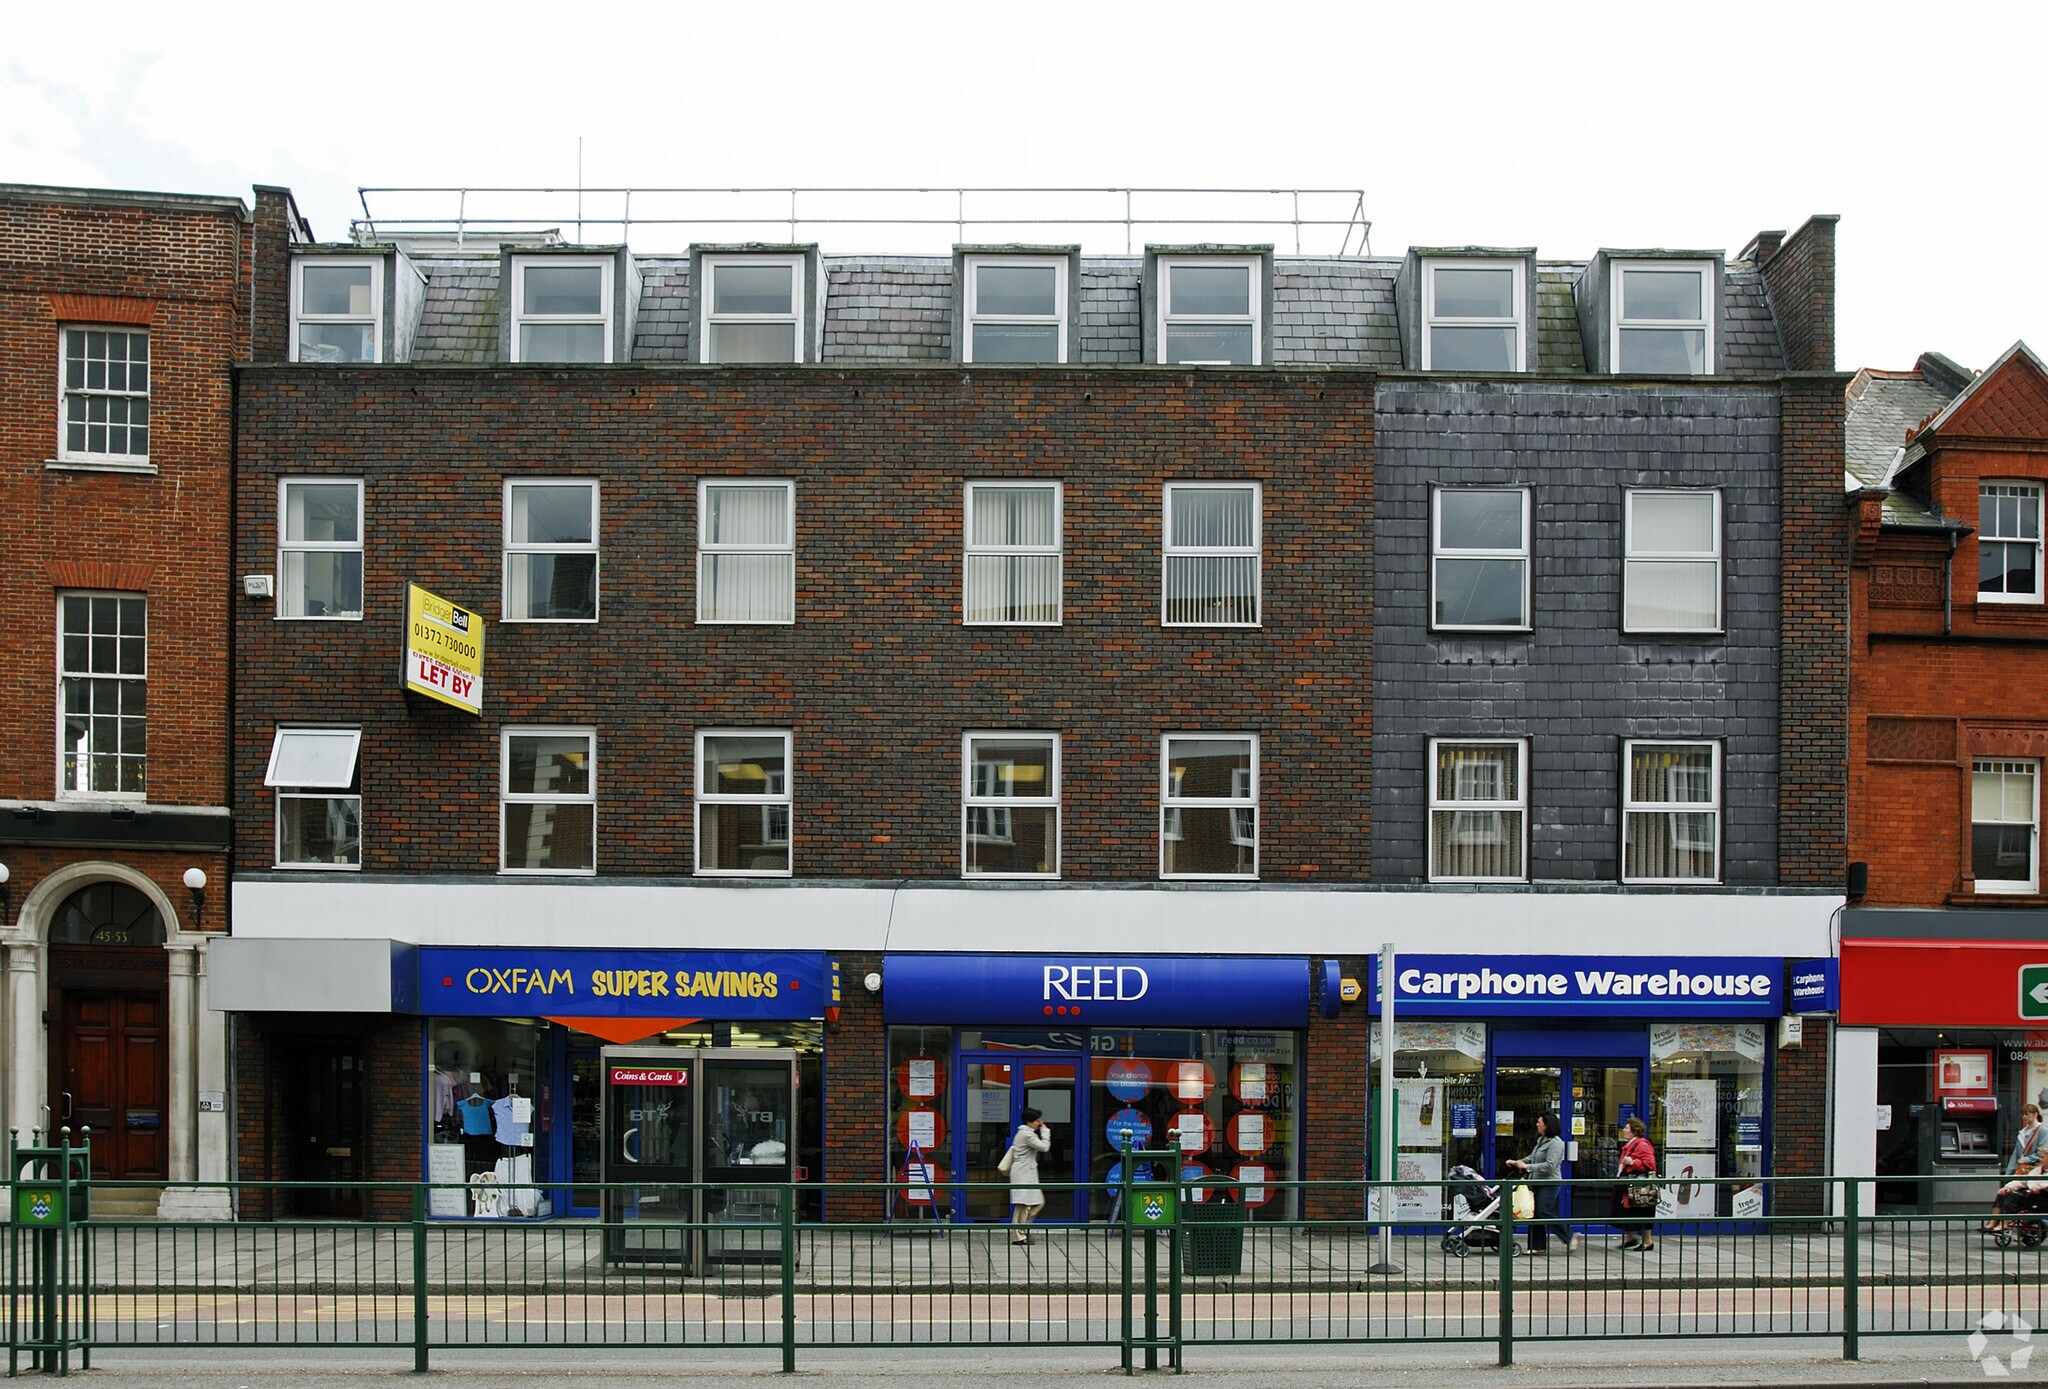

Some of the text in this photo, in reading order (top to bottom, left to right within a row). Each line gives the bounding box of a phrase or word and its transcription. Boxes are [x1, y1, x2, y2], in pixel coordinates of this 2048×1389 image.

[423, 597, 468, 628] Bridger Bell
[414, 622, 476, 659] 01372 730000
[420, 660, 449, 688] LET
[452, 674, 473, 698] BY
[96, 931, 128, 942] 45-53
[465, 968, 778, 998] OXFAM SUPER SAVINGS
[1043, 965, 1148, 1001] REED
[1398, 968, 1771, 1000] Carphone Warehouse
[1796, 973, 1824, 986] Carphone
[1793, 986, 1825, 997] Warehouse
[1466, 1026, 1482, 1038] free
[1654, 1028, 1671, 1040] free
[1744, 1028, 1761, 1040] free
[614, 1070, 673, 1082] Coins & Cards
[1126, 1071, 1149, 1079] chance
[630, 1110, 657, 1122] BT
[1738, 1198, 1754, 1208] free
